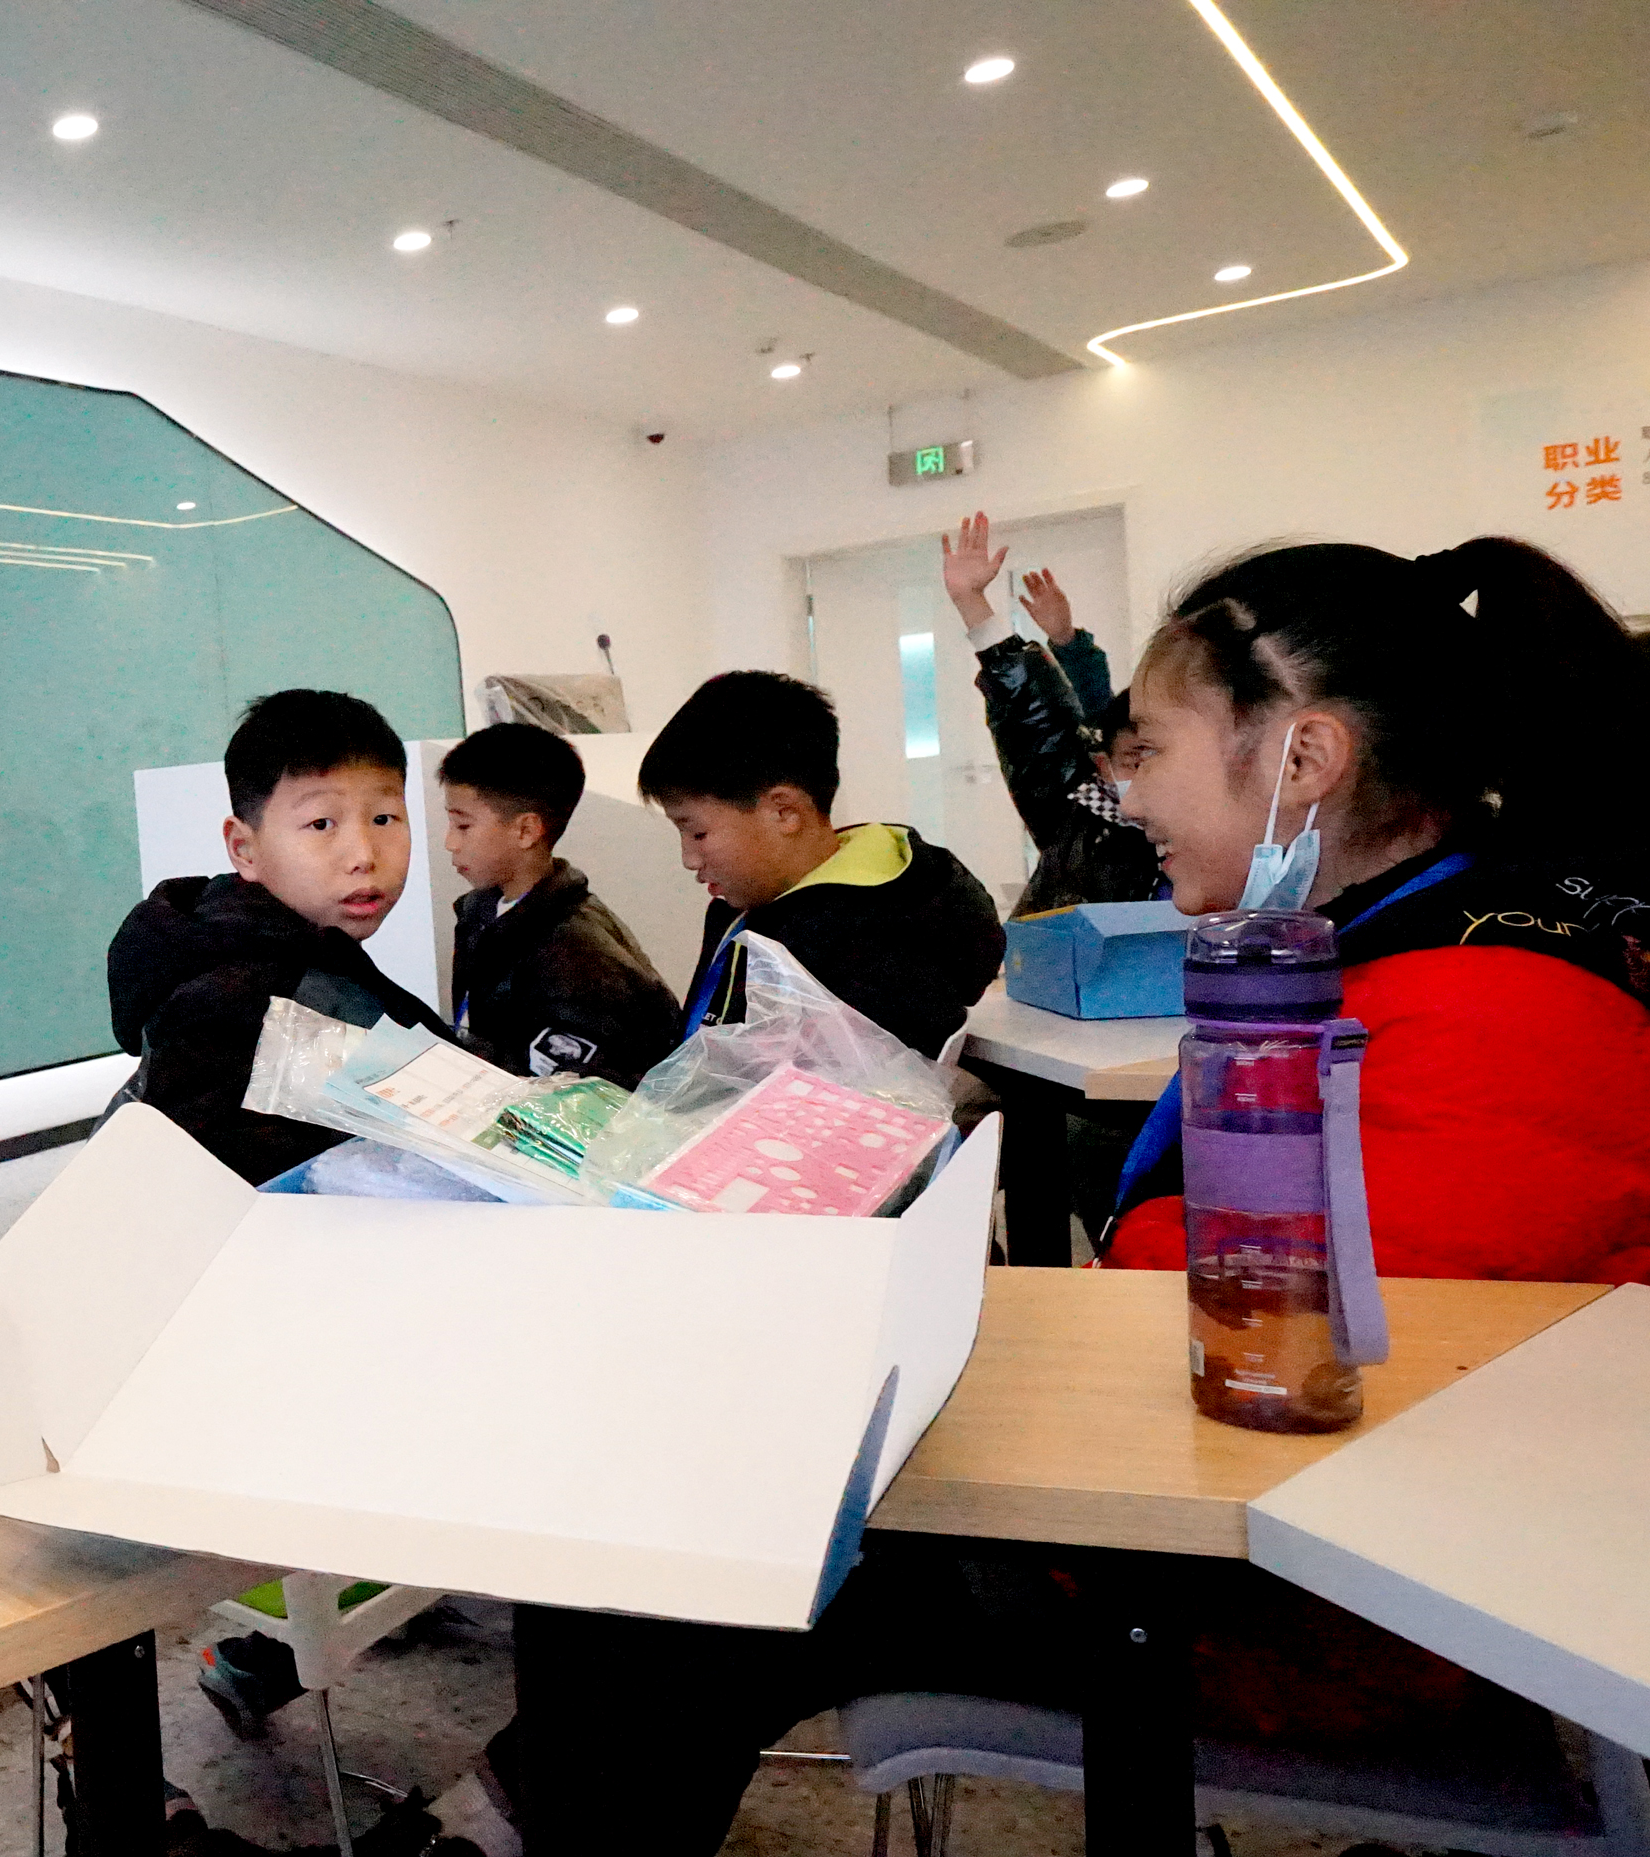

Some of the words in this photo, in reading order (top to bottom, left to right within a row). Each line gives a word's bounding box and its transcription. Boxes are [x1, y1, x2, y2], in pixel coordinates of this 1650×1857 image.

[1543, 436, 1621, 471] 职业
[1545, 474, 1622, 510] 分类
[1459, 910, 1592, 945] your
